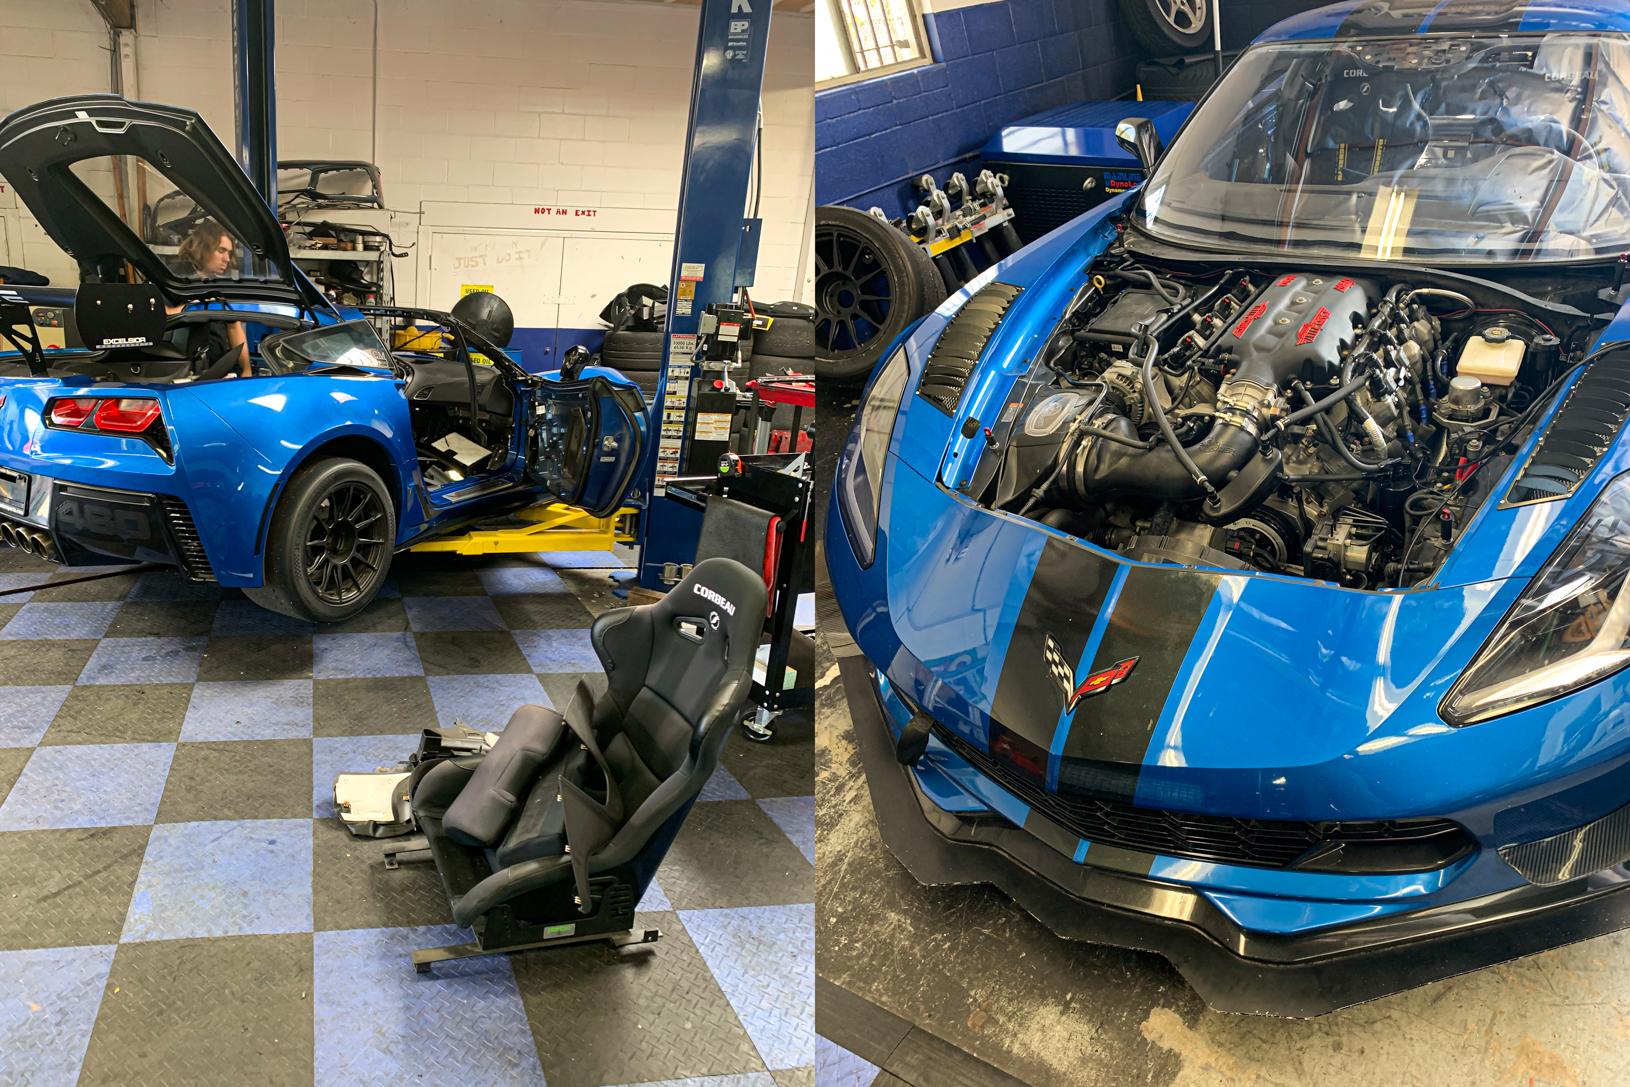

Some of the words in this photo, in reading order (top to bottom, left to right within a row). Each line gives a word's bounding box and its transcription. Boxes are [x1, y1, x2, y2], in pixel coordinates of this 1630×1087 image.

[534, 207, 552, 215] NOT
[555, 208, 568, 216] AN
[575, 209, 597, 217] EXIT
[453, 254, 488, 270] JUST
[693, 583, 736, 617] CORBEAU
